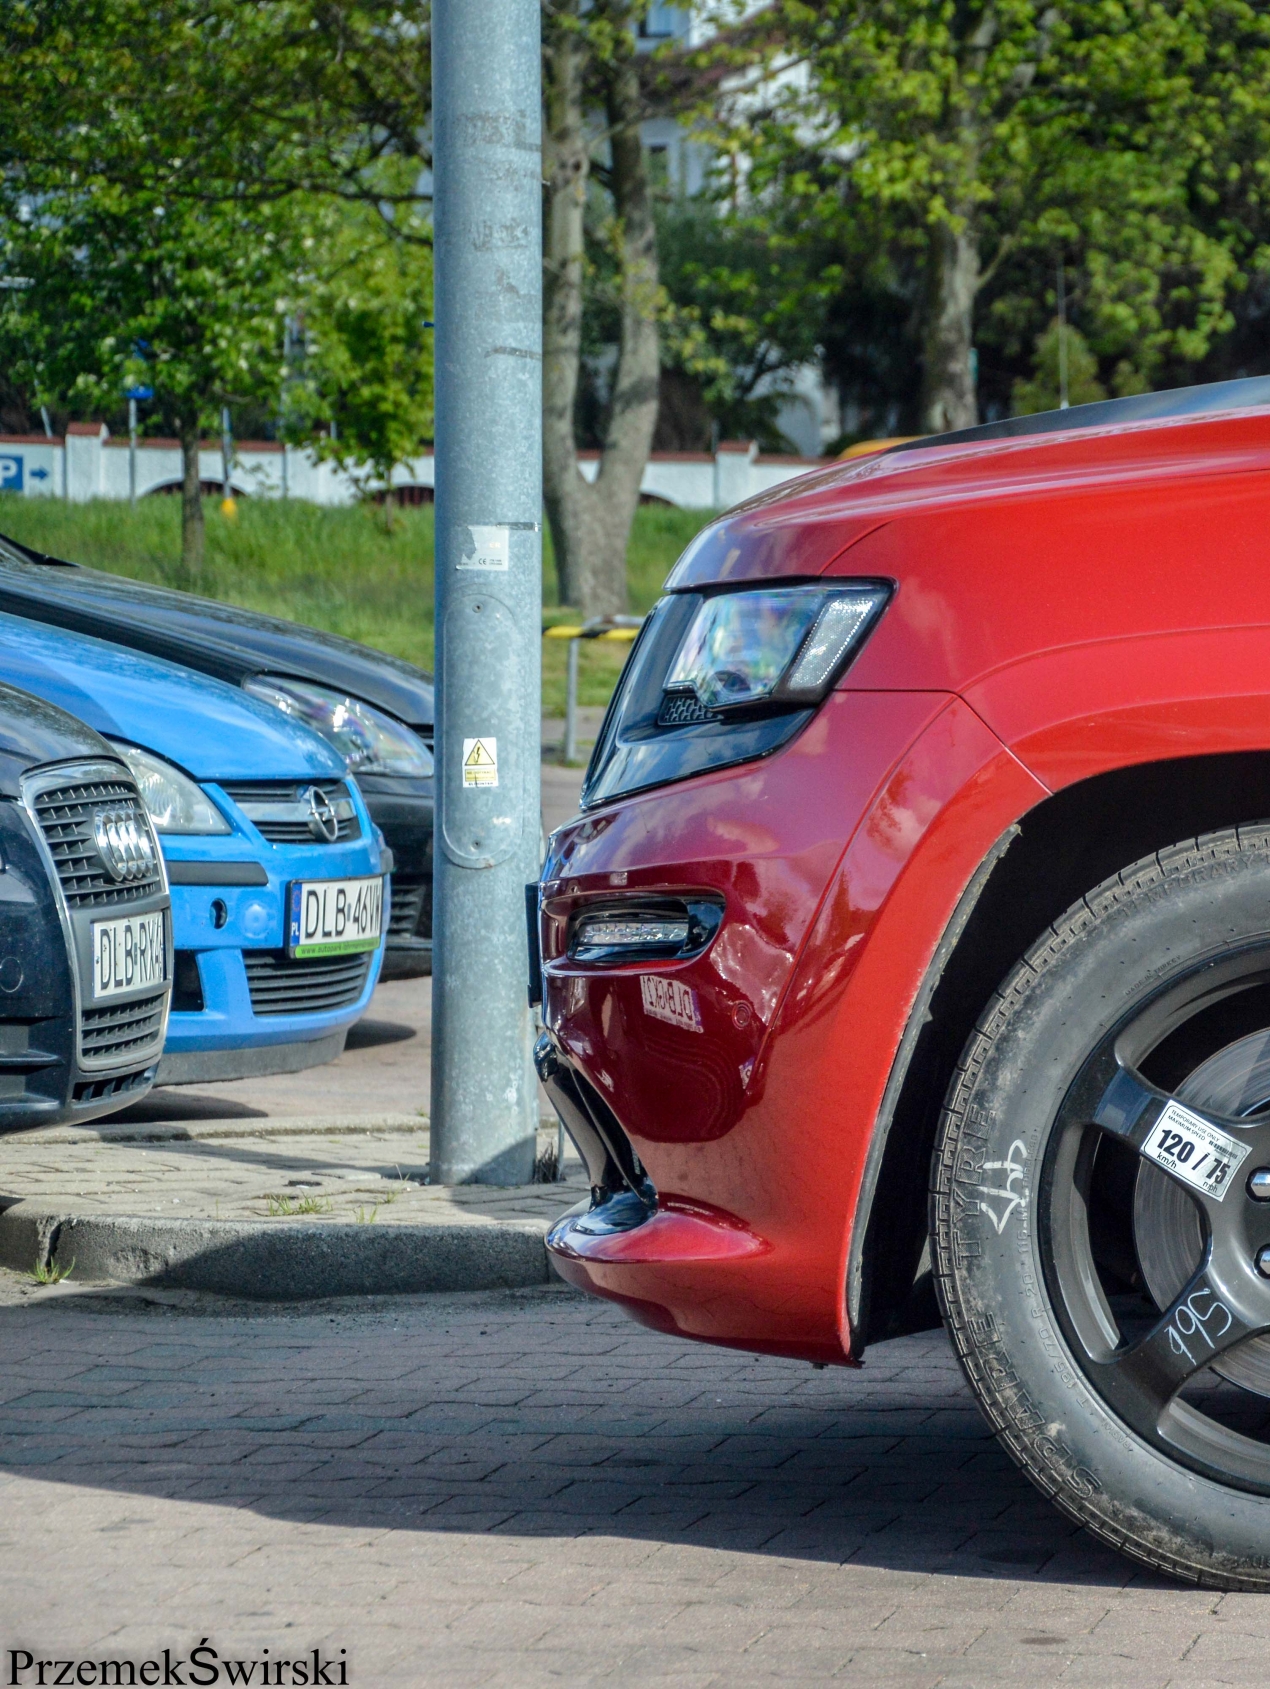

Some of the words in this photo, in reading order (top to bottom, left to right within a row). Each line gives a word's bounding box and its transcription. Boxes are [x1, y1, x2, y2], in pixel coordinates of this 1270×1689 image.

[0, 458, 18, 487] P
[291, 922, 299, 936] PL
[305, 888, 346, 939] DLB
[100, 924, 133, 991] DLB
[1167, 1115, 1192, 1132] MAXIMUM
[1191, 1129, 1206, 1141] SPEED
[1171, 1109, 1199, 1131] TEMPORARY
[1197, 1126, 1207, 1136] USE
[1206, 1131, 1221, 1142] ONLY
[1156, 1151, 1177, 1169] km/h
[1202, 1181, 1218, 1193] mph
[1157, 1129, 1196, 1164] 120
[1206, 1157, 1231, 1184] 75
[952, 1104, 997, 1269] TYRE
[967, 1311, 1102, 1499] SPARE
